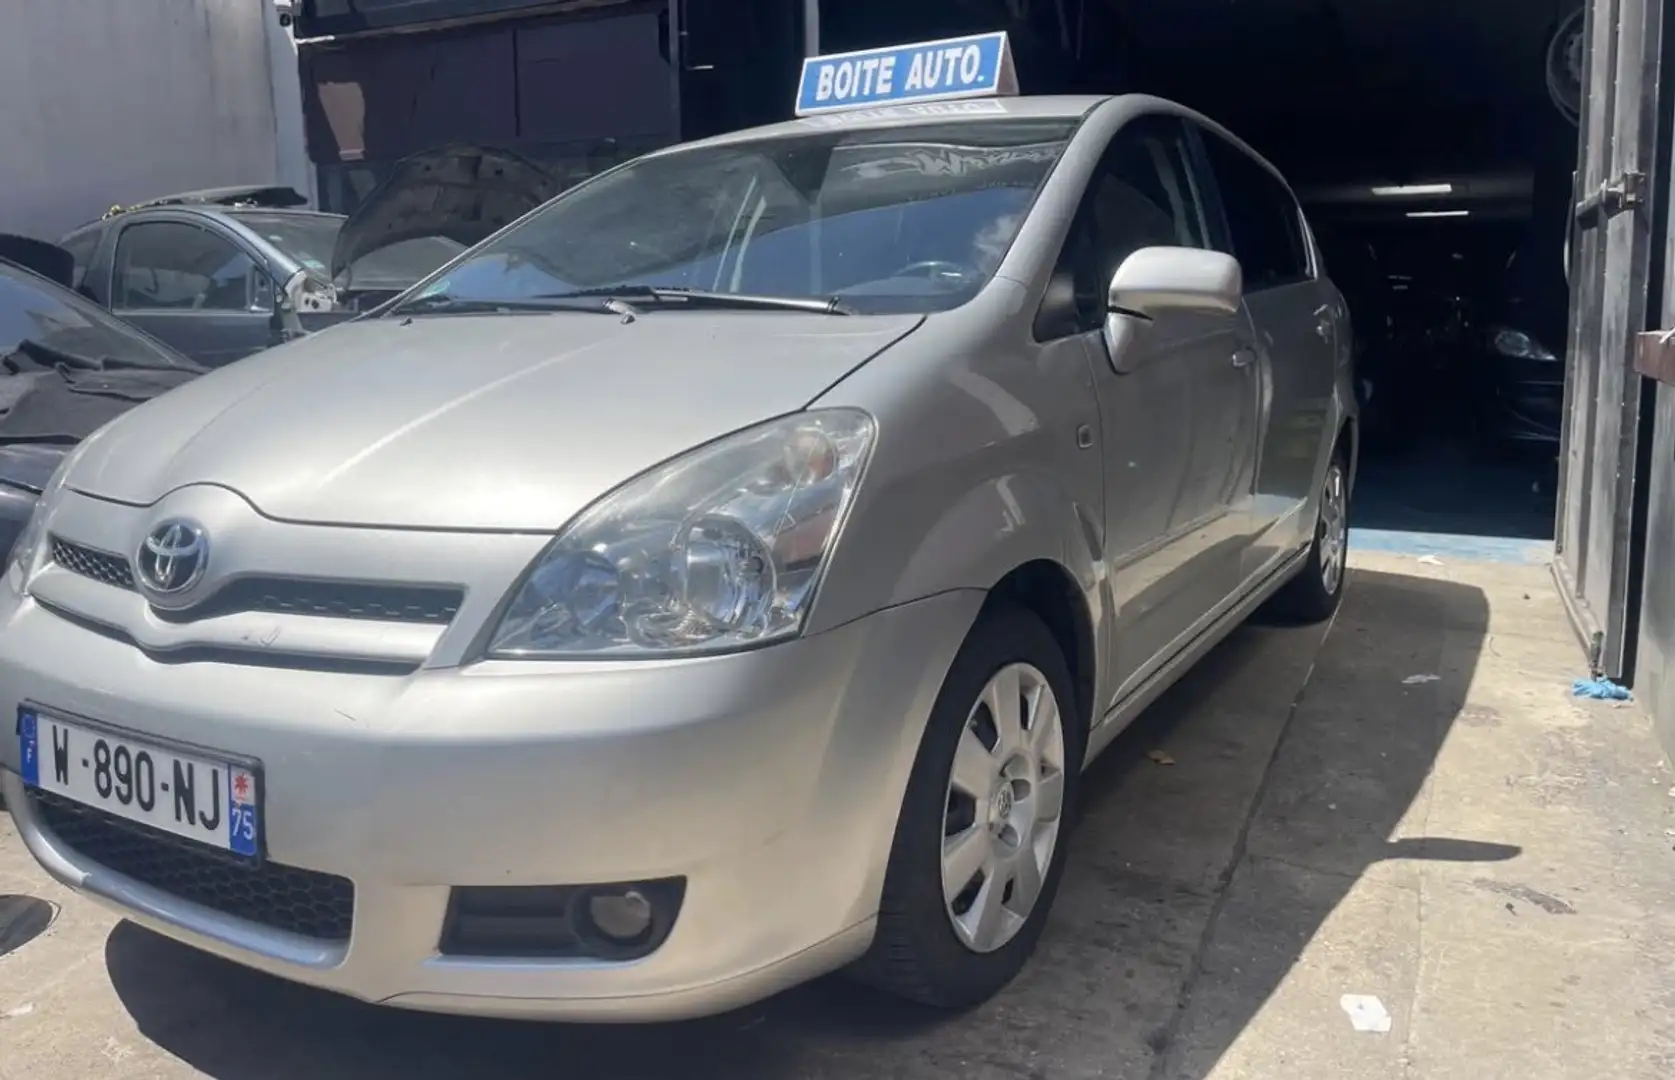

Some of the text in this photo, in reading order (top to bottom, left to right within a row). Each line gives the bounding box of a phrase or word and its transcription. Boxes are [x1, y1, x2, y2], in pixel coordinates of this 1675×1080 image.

[816, 44, 985, 101] BOITE AUTO.
[231, 806, 254, 841] 75
